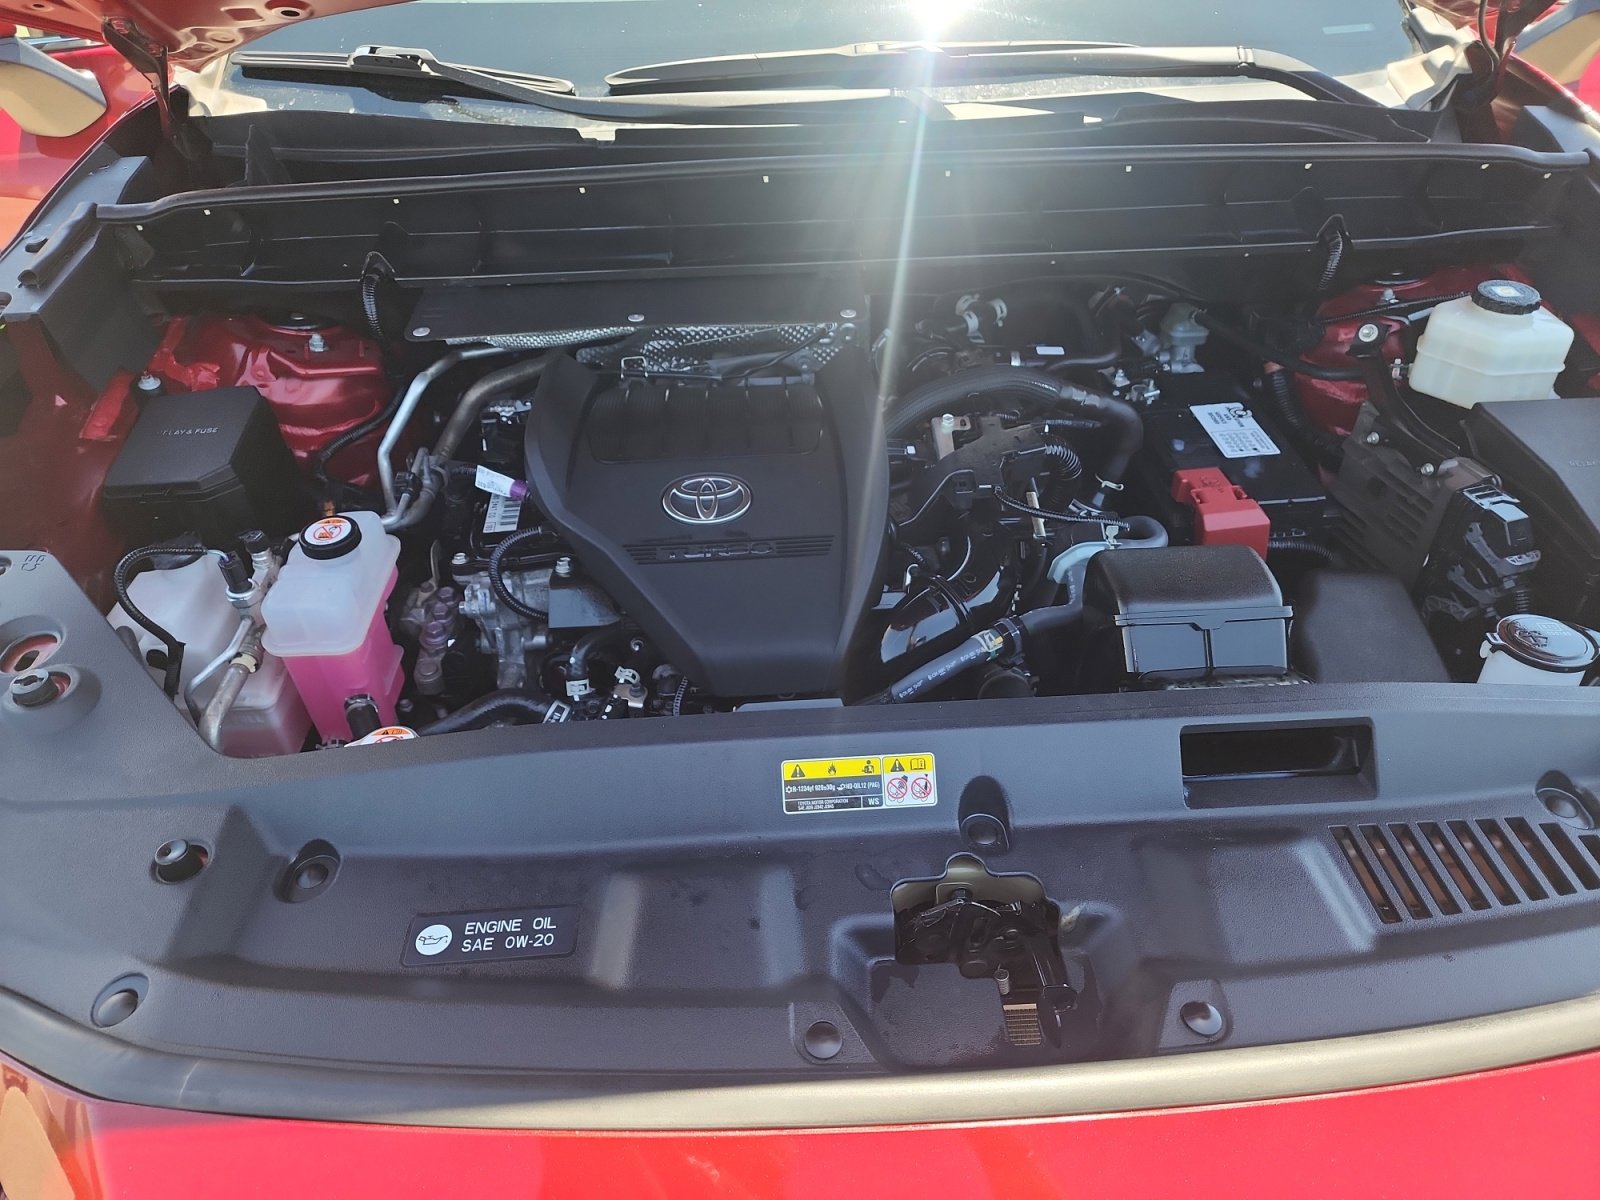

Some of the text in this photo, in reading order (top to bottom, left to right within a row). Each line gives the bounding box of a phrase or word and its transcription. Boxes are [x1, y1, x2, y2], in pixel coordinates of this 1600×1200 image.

[194, 427, 219, 435] FUSE
[464, 917, 557, 935] ENGINE OIL
[461, 933, 555, 952] SAE 0W-20
